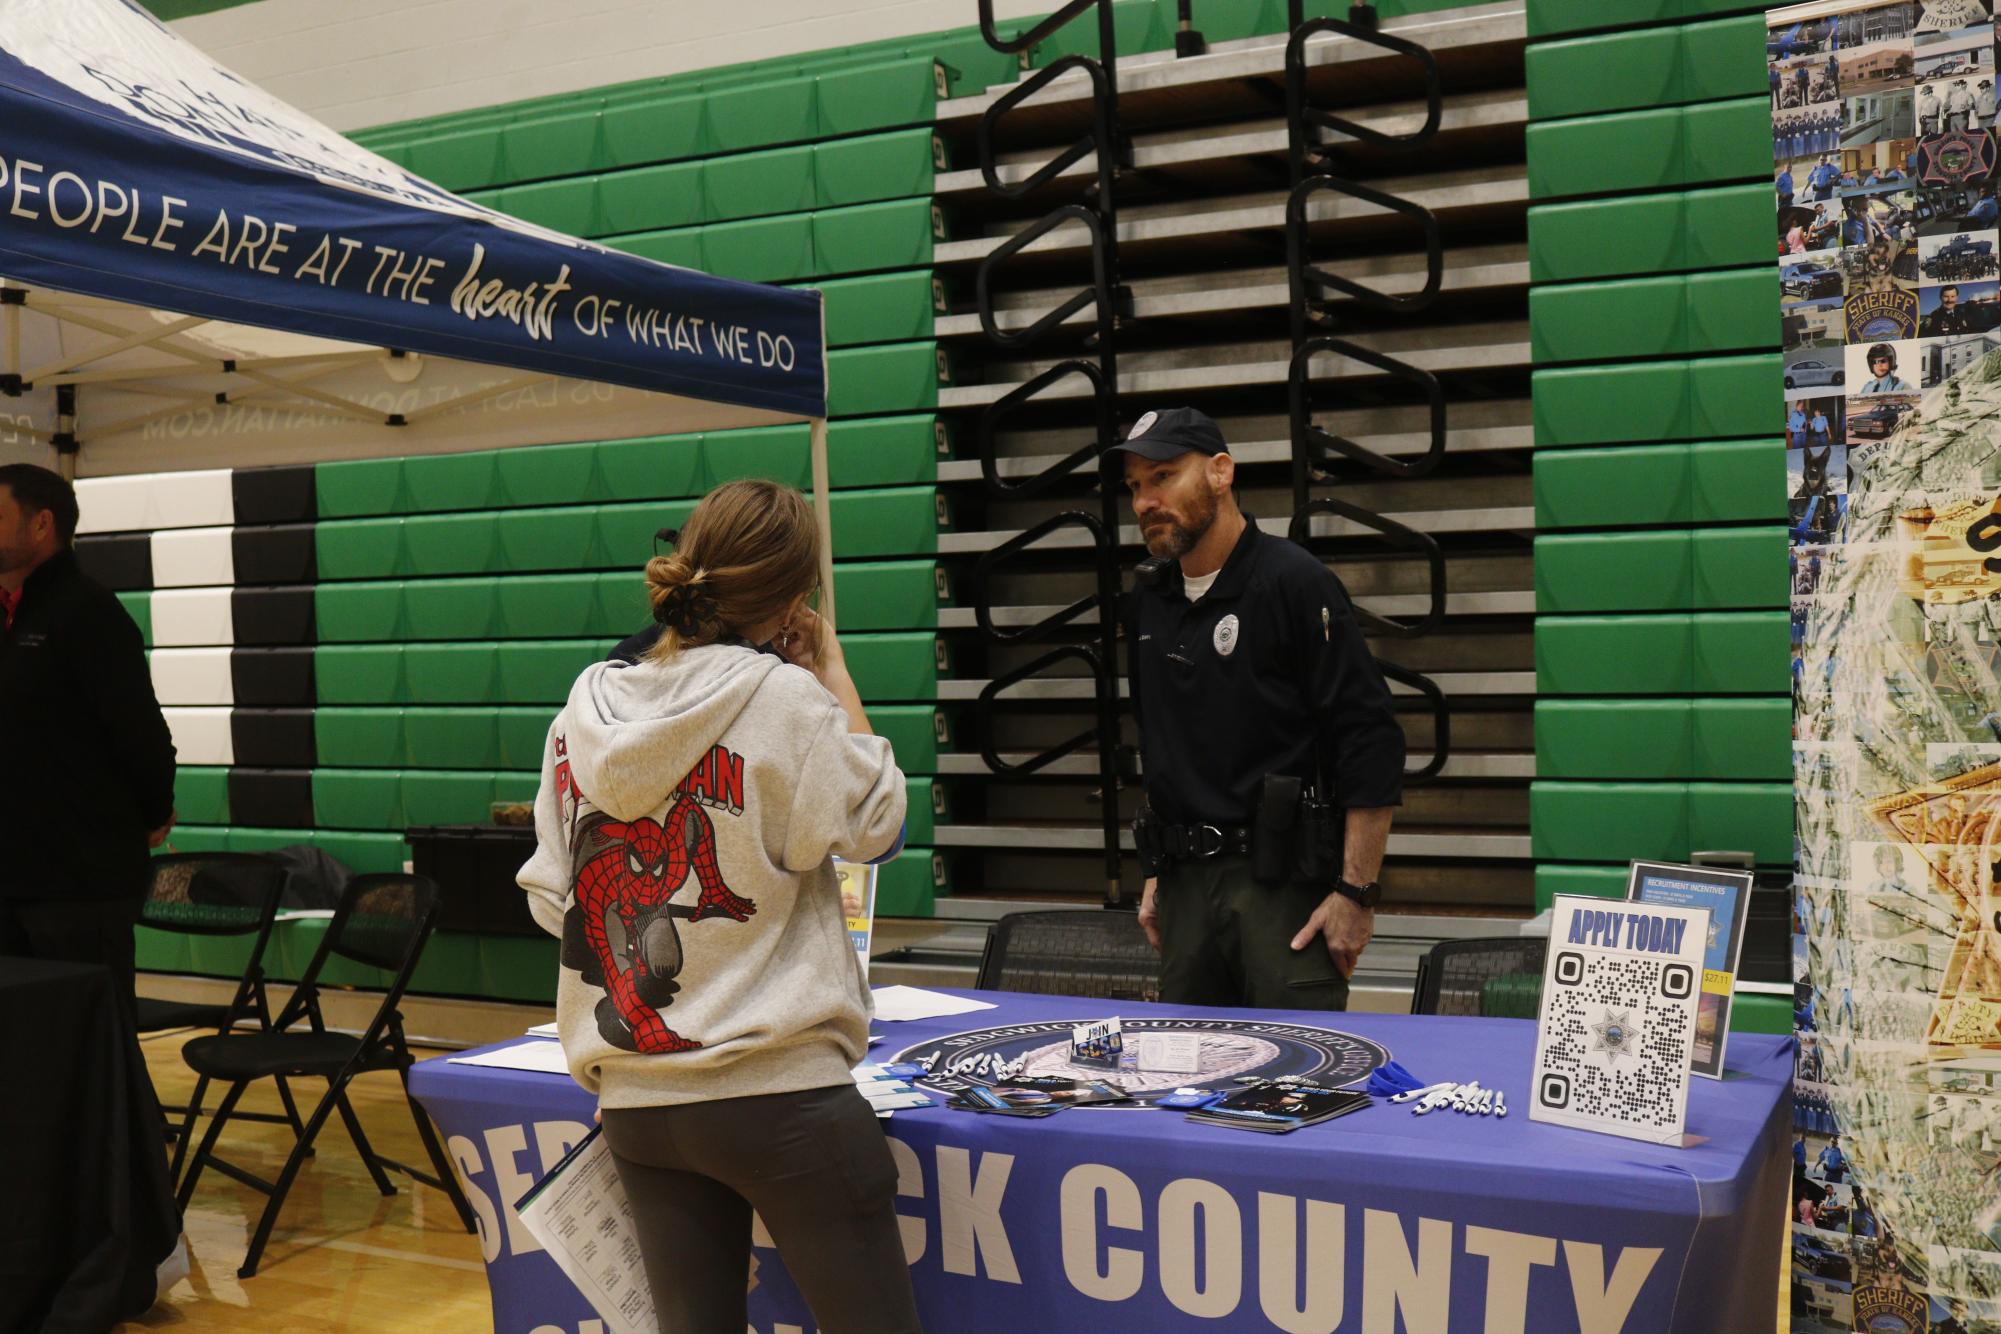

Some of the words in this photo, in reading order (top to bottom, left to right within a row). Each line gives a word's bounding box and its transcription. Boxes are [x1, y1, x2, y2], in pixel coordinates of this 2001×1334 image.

[192, 208, 297, 274] ARE
[294, 233, 362, 287] AT
[366, 246, 446, 305] THE
[450, 243, 571, 341] heart
[574, 295, 622, 338] OF
[626, 304, 704, 356] WHAT
[711, 321, 753, 364] WE
[757, 331, 796, 371] DO
[1848, 292, 1914, 320] SHERIFF
[1647, 879, 1689, 891] RECRUITMENT
[1690, 884, 1726, 895] INCENTIVES
[1567, 908, 1625, 947] APPLY
[1625, 914, 1687, 955] TODAY
[1704, 973, 1729, 985] $27.11
[1119, 1019, 1246, 1031] OUNTY
[1060, 1163, 1664, 1334] COUNTY
[1856, 1288, 1923, 1314] SHERIFF
